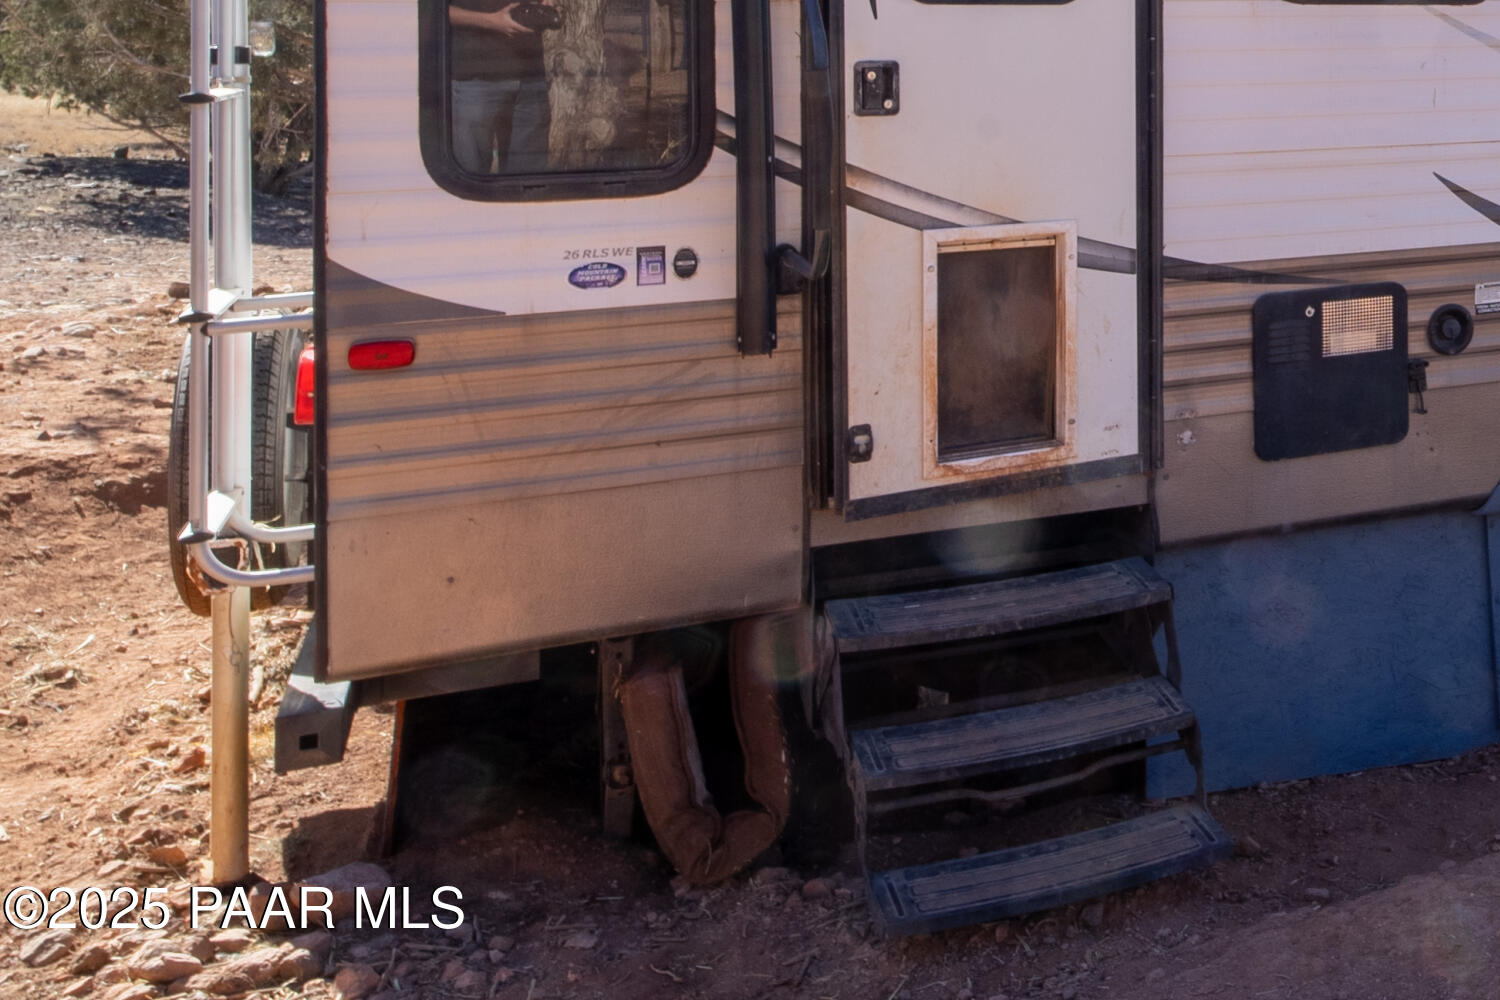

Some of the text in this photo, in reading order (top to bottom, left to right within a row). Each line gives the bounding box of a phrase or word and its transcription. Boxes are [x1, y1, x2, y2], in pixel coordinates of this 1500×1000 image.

[563, 246, 634, 260] 26 RLS WE
